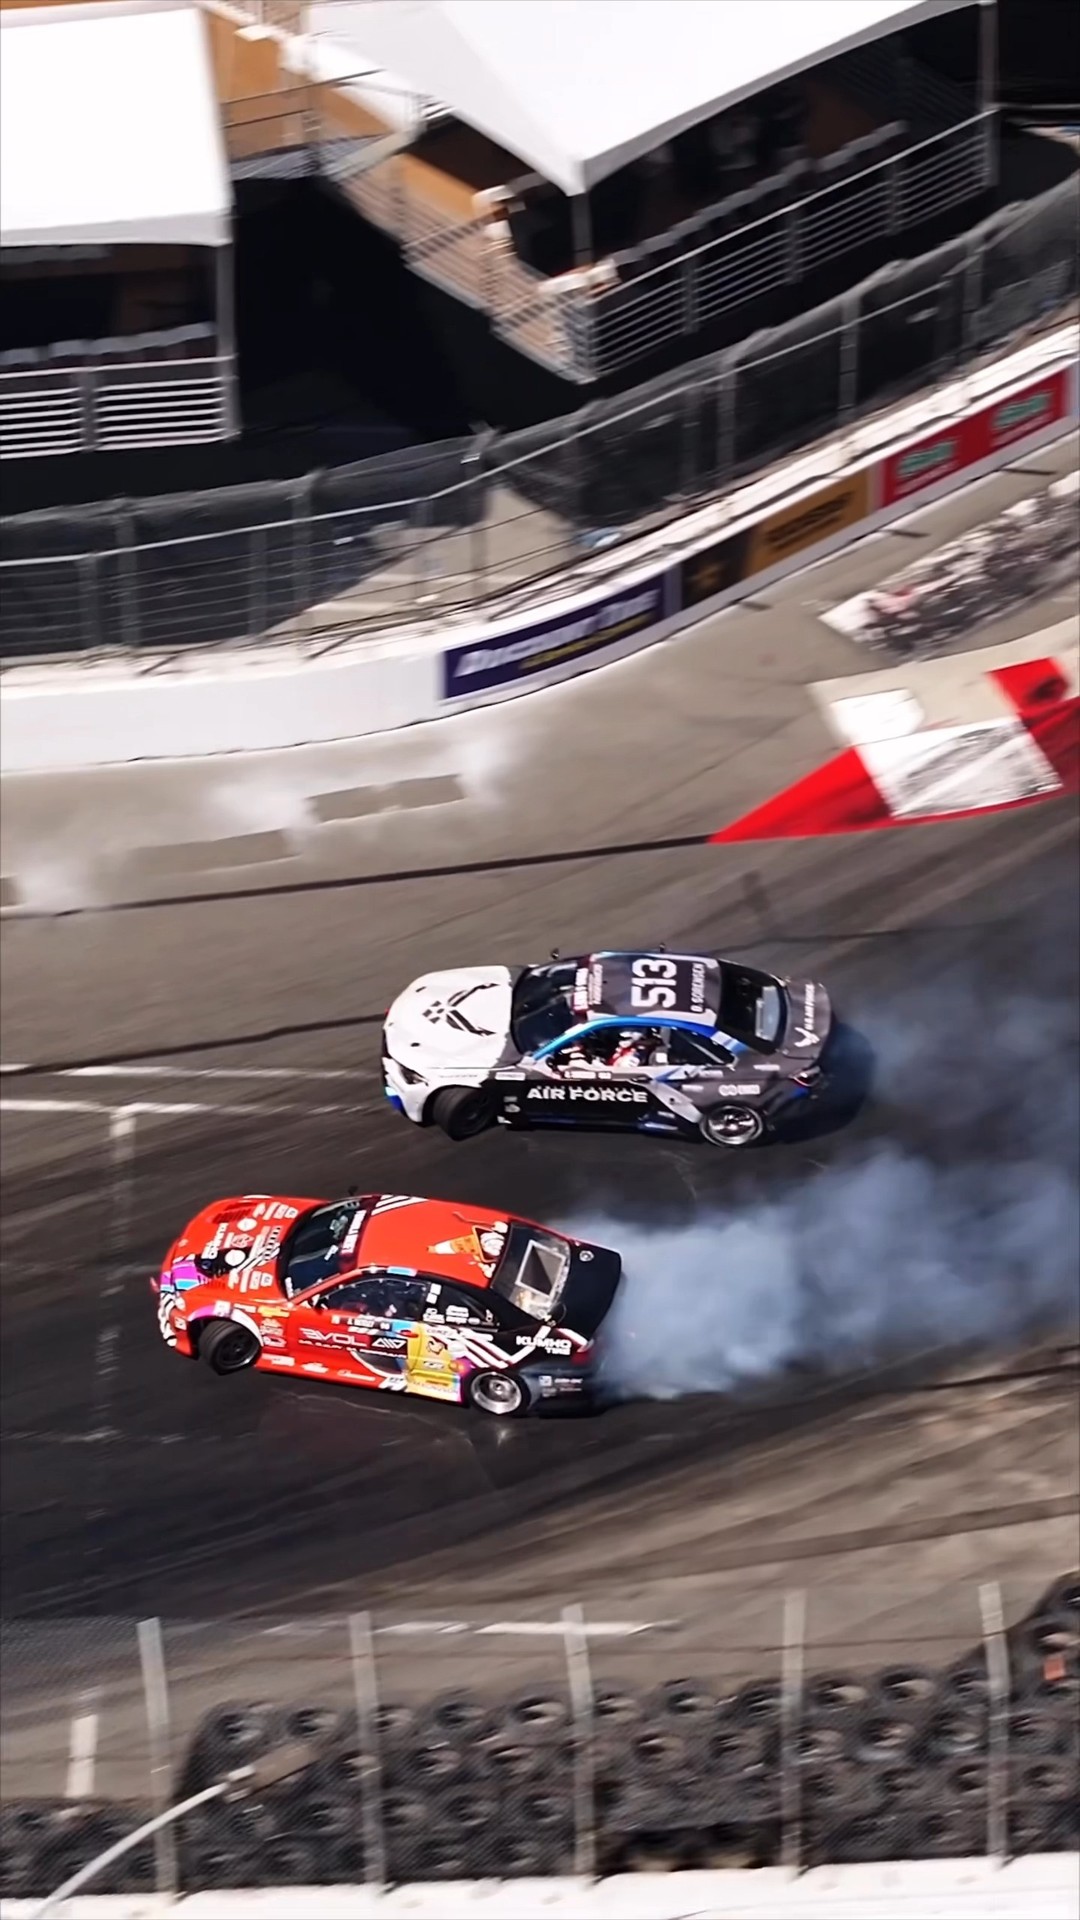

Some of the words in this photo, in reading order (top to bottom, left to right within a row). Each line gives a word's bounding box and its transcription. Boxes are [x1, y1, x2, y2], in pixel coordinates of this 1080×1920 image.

[631, 958, 678, 1009] 513
[527, 1087, 566, 1100] AIR
[569, 1088, 648, 1103] FORCE
[516, 1335, 573, 1350] KUMHO
